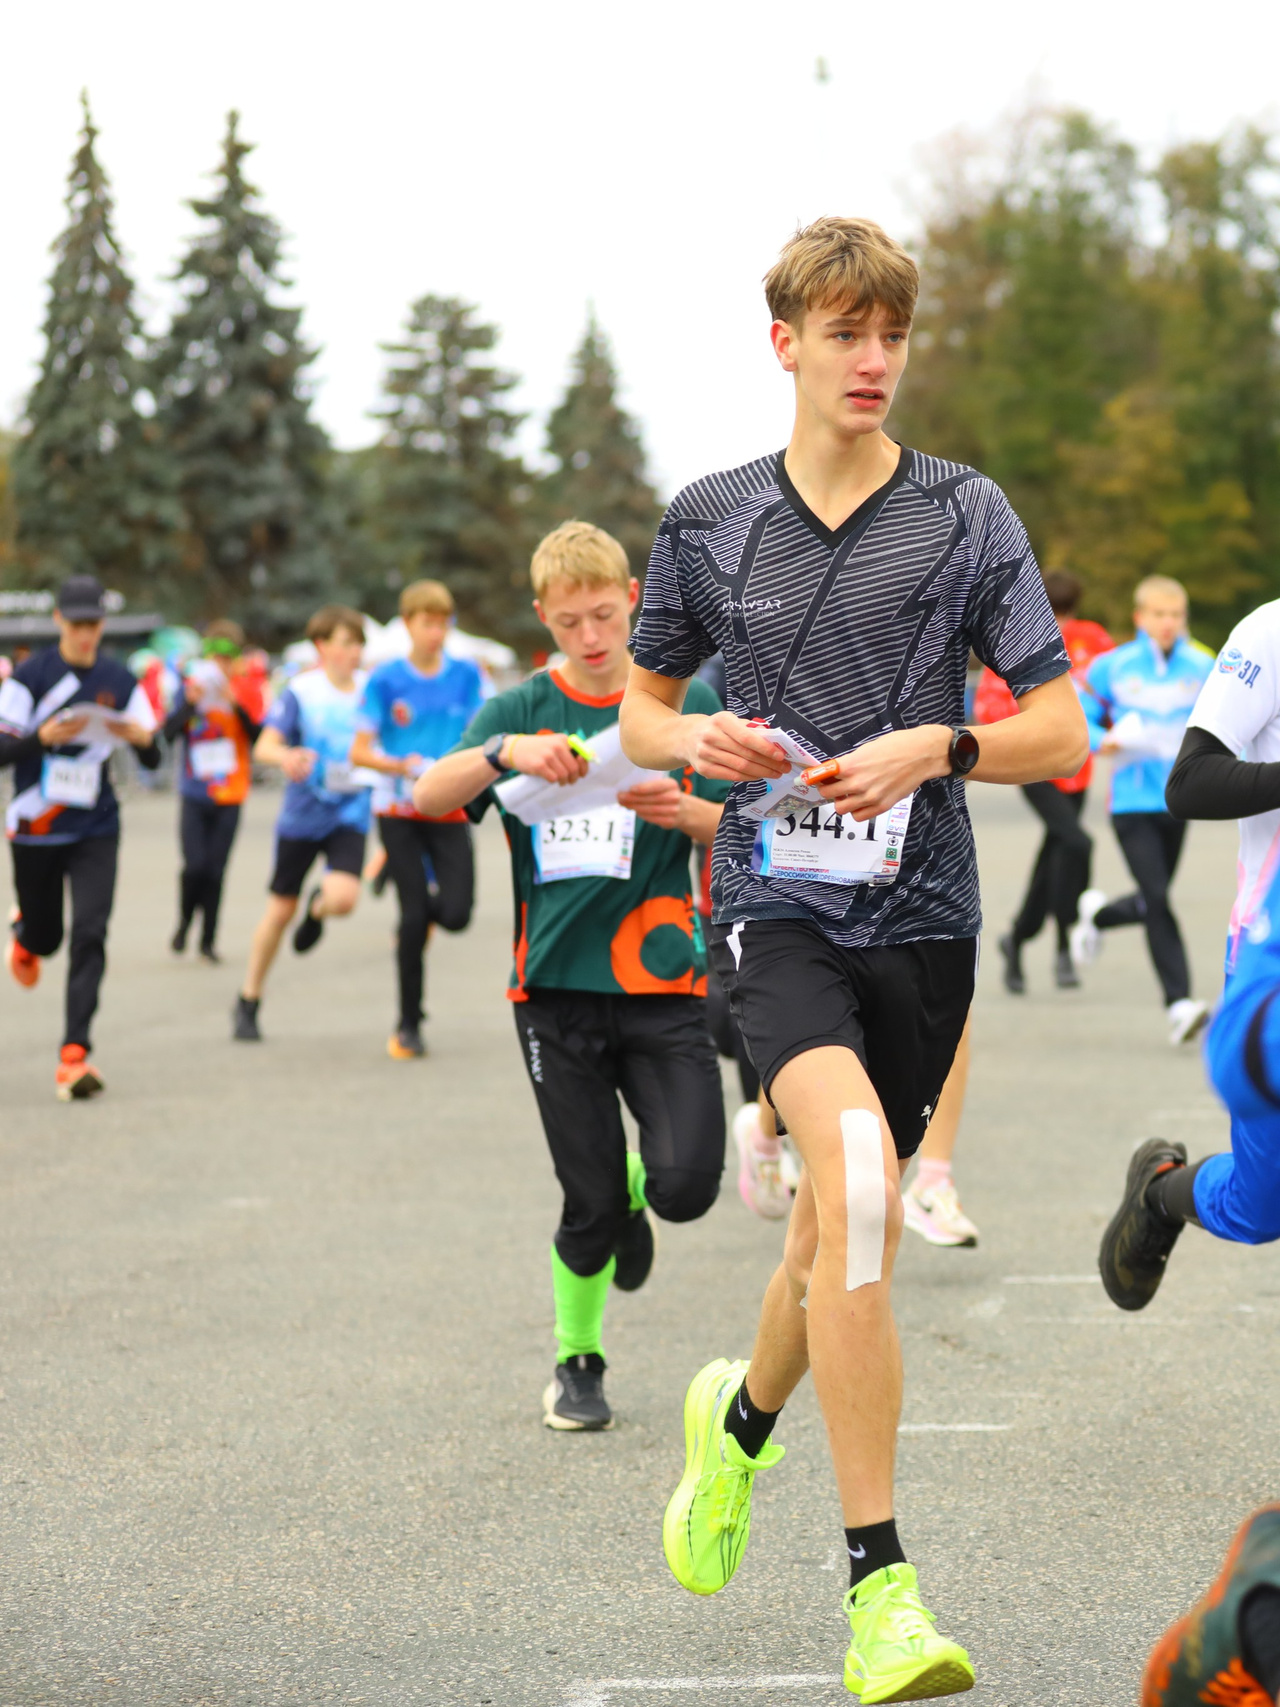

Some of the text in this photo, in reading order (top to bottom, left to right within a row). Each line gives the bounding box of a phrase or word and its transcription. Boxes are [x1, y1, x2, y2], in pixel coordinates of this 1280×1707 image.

[722, 599, 781, 611] ARSWEAR
[543, 818, 616, 844] 323.1
[776, 806, 879, 841] 344.1
